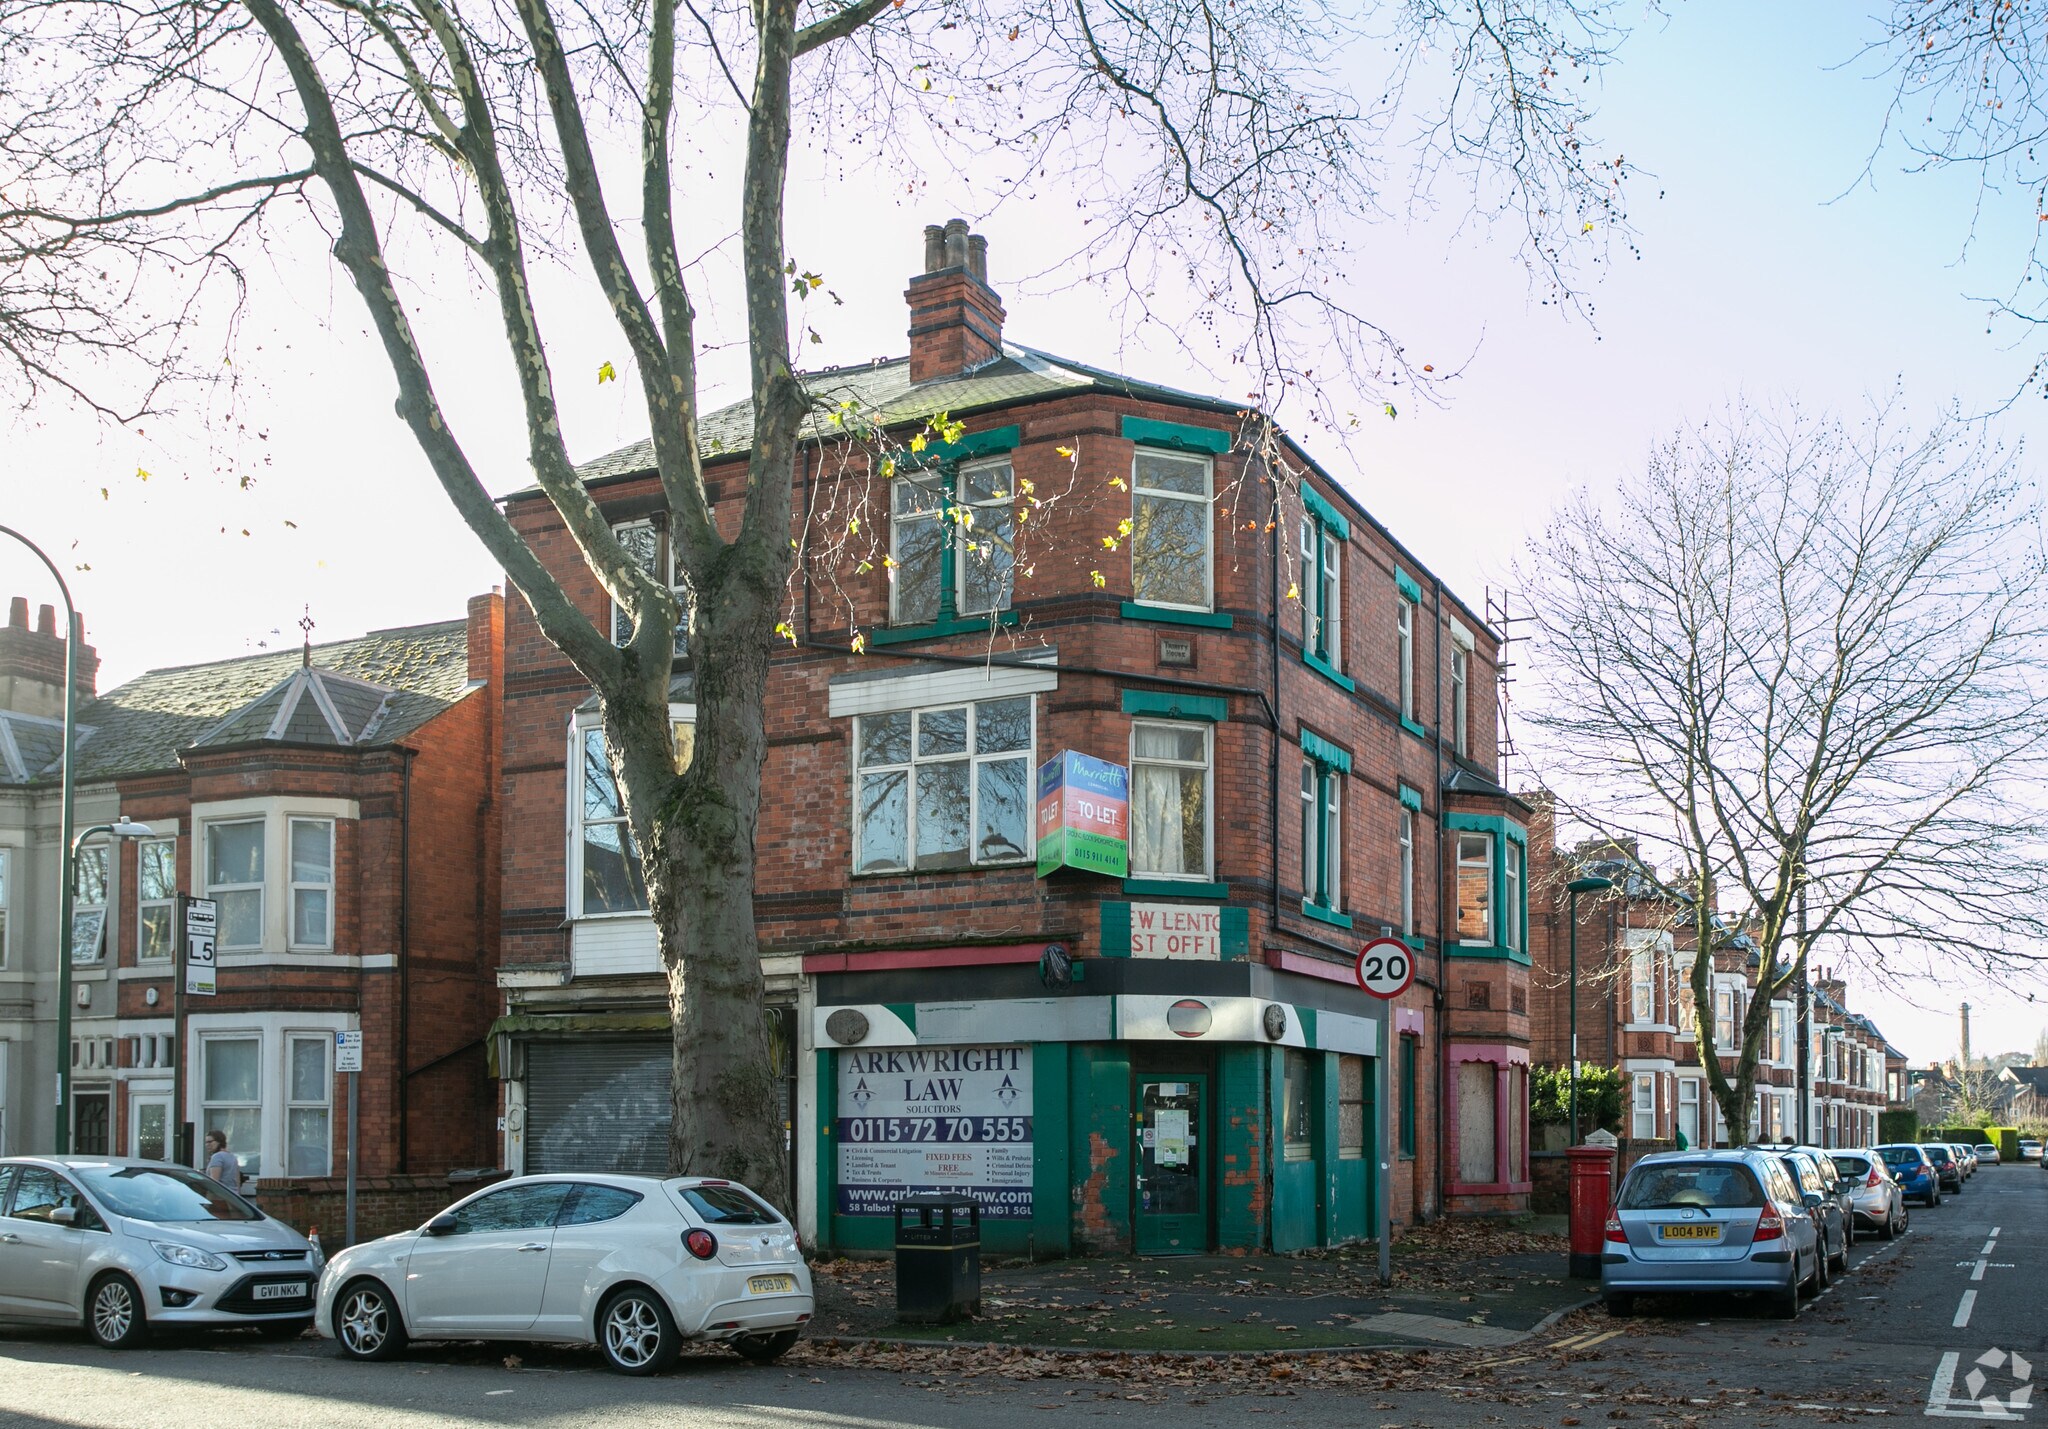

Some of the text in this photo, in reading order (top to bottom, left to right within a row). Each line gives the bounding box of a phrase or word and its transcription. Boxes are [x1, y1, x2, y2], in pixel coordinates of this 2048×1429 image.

[1073, 759, 1124, 787] Marriotts
[1041, 801, 1058, 825] TO LET
[1078, 800, 1117, 825] TO LET
[1075, 848, 1119, 866] 0115 911 4141
[189, 940, 213, 961] L5
[1132, 934, 1157, 953] ST
[1365, 955, 1406, 981] 20
[848, 1048, 1024, 1074] ARKWRIGHT
[904, 1078, 963, 1101] LAW
[906, 1105, 961, 1114] SOLICITORS
[850, 1118, 1025, 1142] 0115 72 70 555
[925, 1153, 972, 1161] FIXED FEES
[848, 1203, 860, 1212] 58
[863, 1203, 890, 1212] Talbot
[988, 1206, 1009, 1215] NG1
[1013, 1206, 1033, 1215] 5GL
[1664, 1226, 1718, 1237] LO04 BVF
[260, 1284, 299, 1297] GV11 NKK
[751, 1279, 774, 1292] FP09
